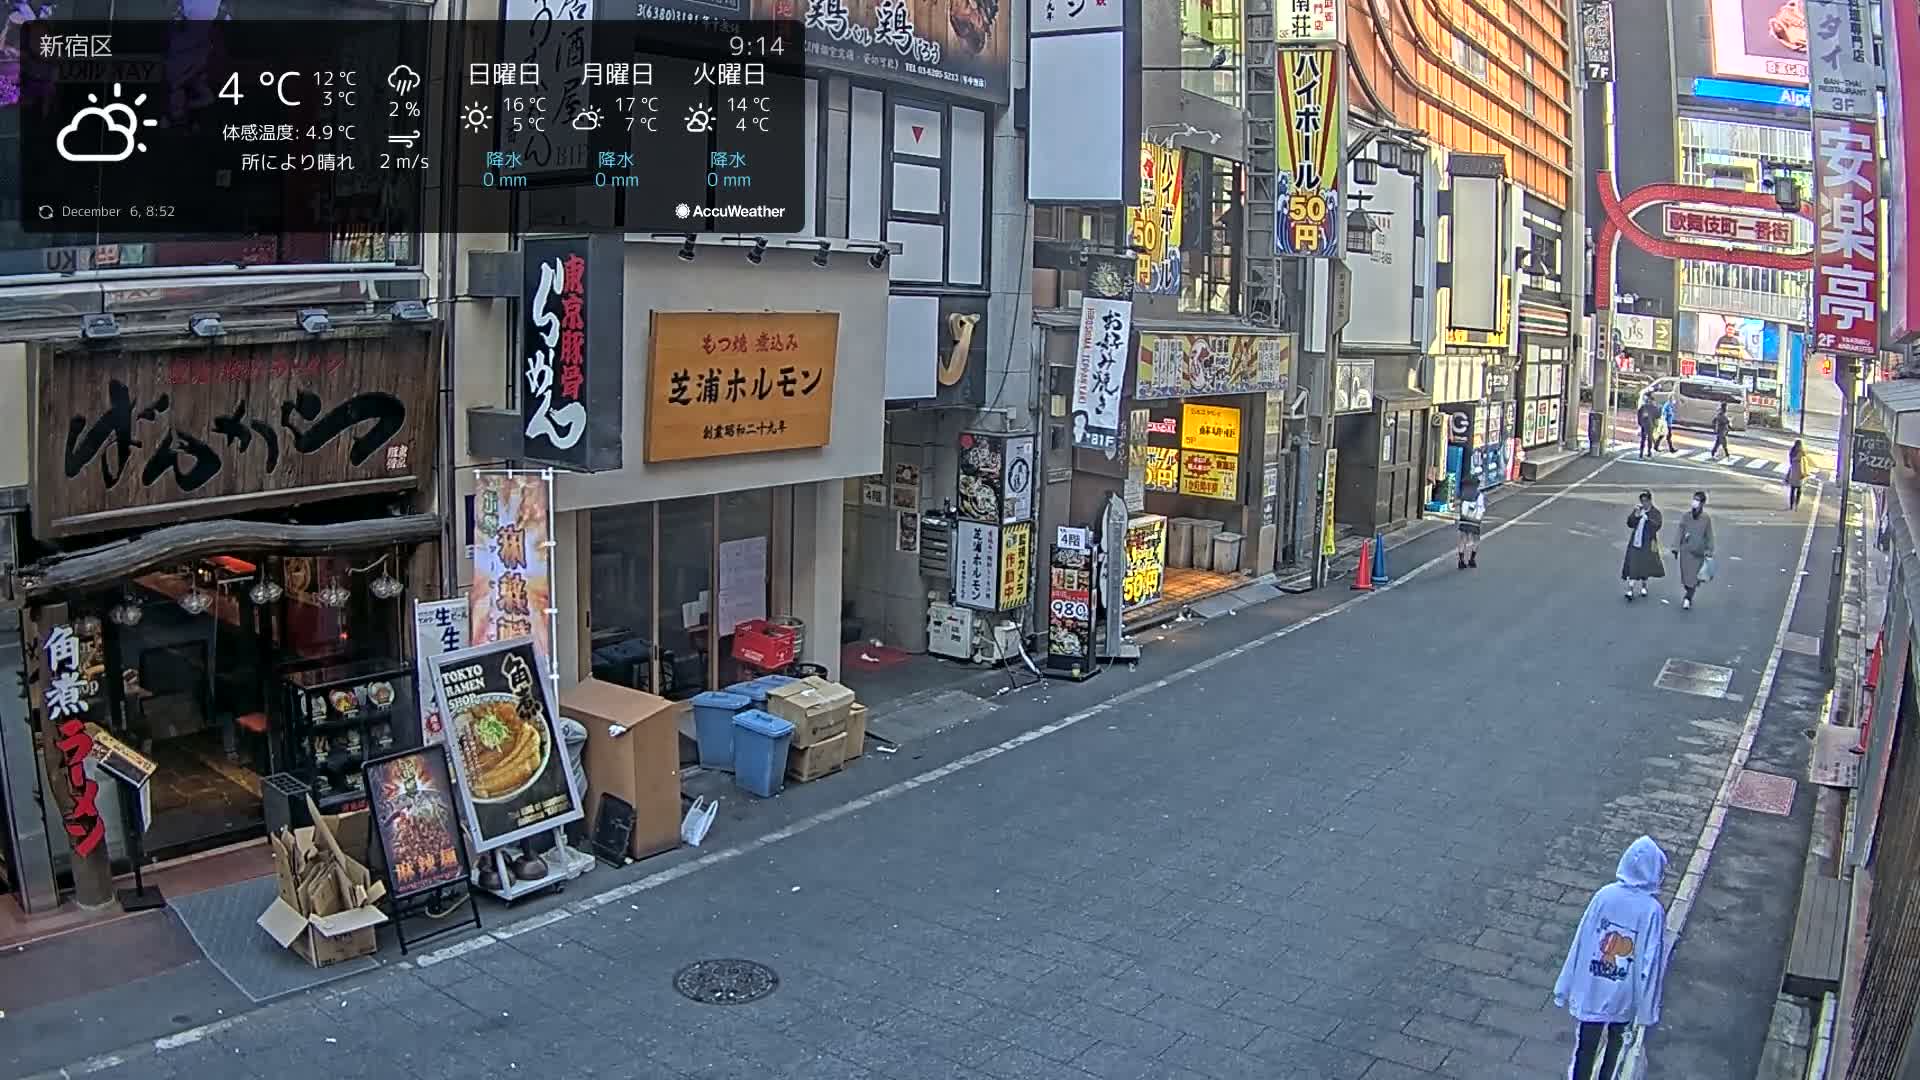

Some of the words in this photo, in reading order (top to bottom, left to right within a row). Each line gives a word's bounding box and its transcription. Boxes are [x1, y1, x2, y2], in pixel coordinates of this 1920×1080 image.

[1588, 63, 1610, 79] 7F
[1293, 54, 1321, 191] ハイボール
[1161, 152, 1174, 288] ハイボール
[1669, 211, 1789, 241] 歌舞伎町一番街
[1819, 126, 1877, 331] 安楽亭
[560, 252, 585, 400] 東京豚骨
[1817, 332, 1837, 348] 2F
[754, 331, 800, 353] 煮込み
[1095, 309, 1125, 415] お好み焼き
[668, 366, 824, 406] 芝浦ホルモン
[441, 663, 484, 685] TOKYO
[444, 676, 487, 698] RAMEN
[447, 691, 481, 712] SHOP
